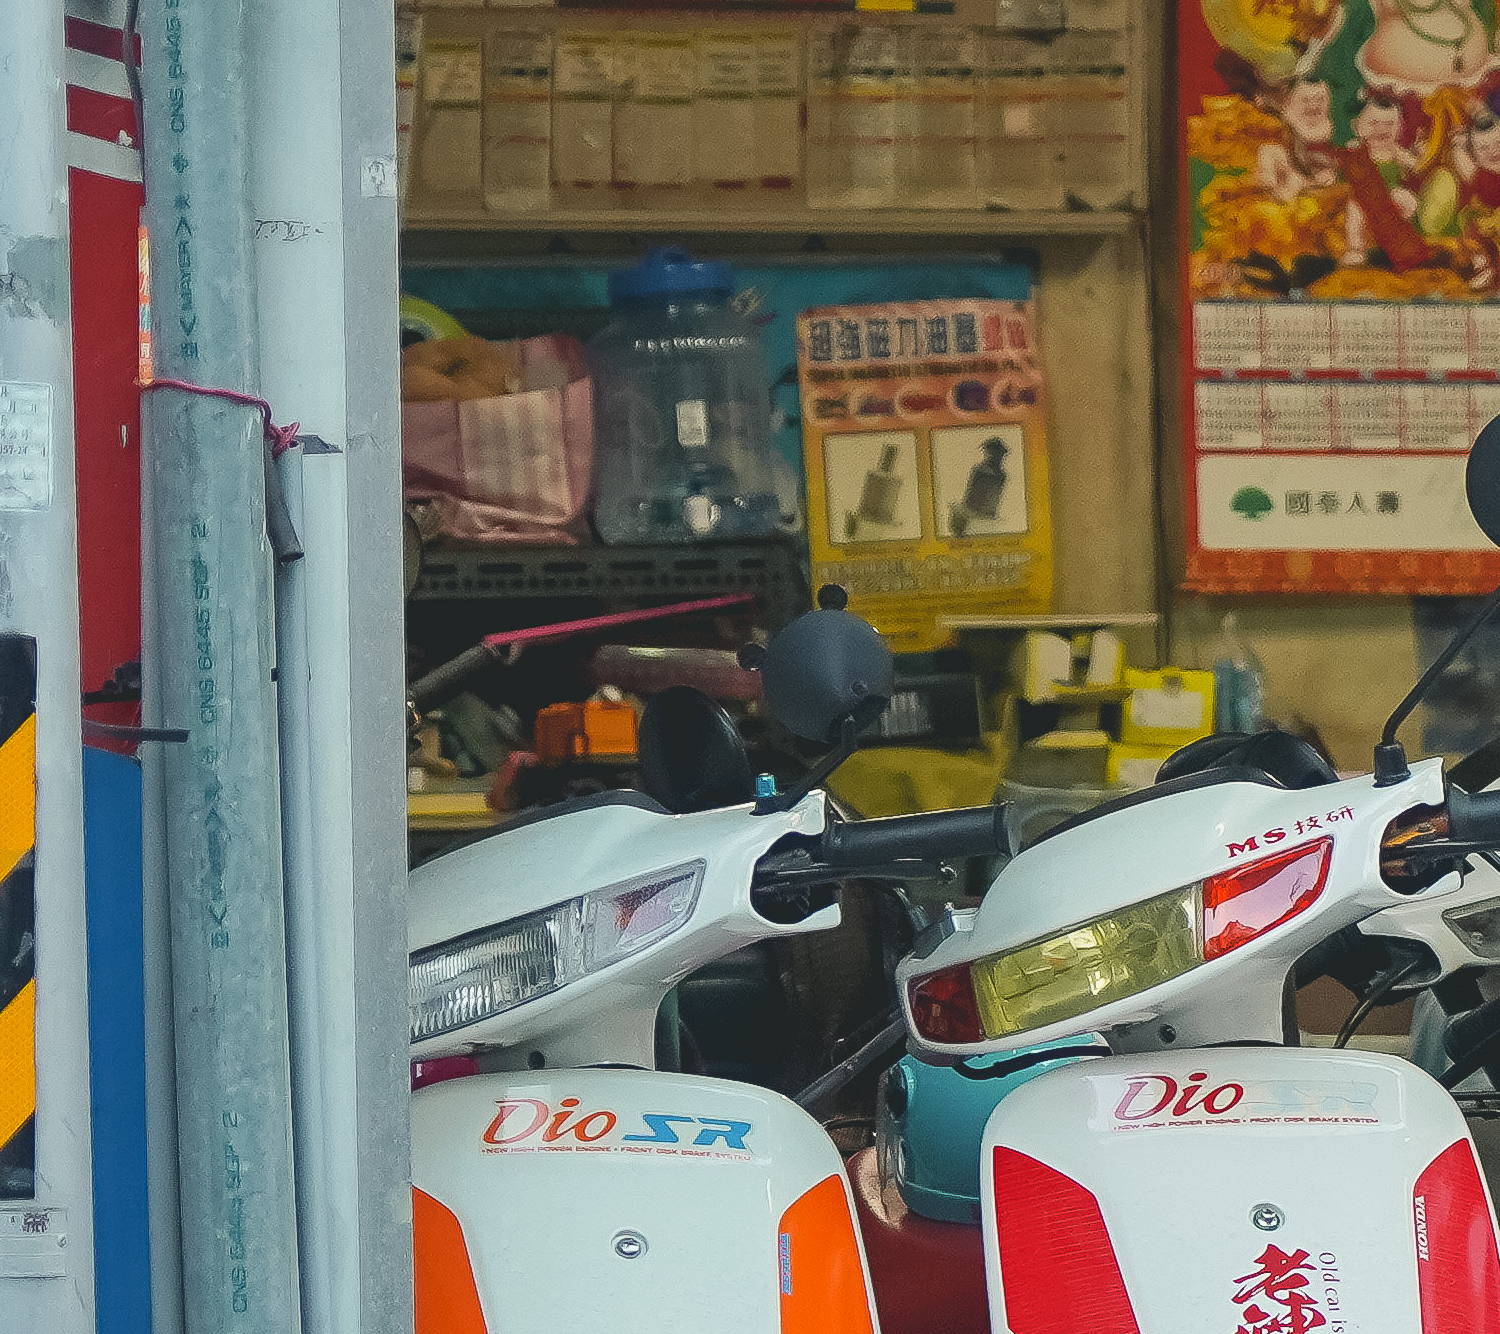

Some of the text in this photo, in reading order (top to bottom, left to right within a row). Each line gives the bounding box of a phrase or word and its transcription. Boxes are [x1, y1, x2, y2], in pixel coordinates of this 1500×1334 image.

[167, 88, 186, 134] CNS
[1226, 805, 1358, 858] MS 技研
[1114, 1072, 1244, 1121] Dio
[482, 1097, 753, 1150] Dio SR
[1414, 1195, 1429, 1260] HONDA
